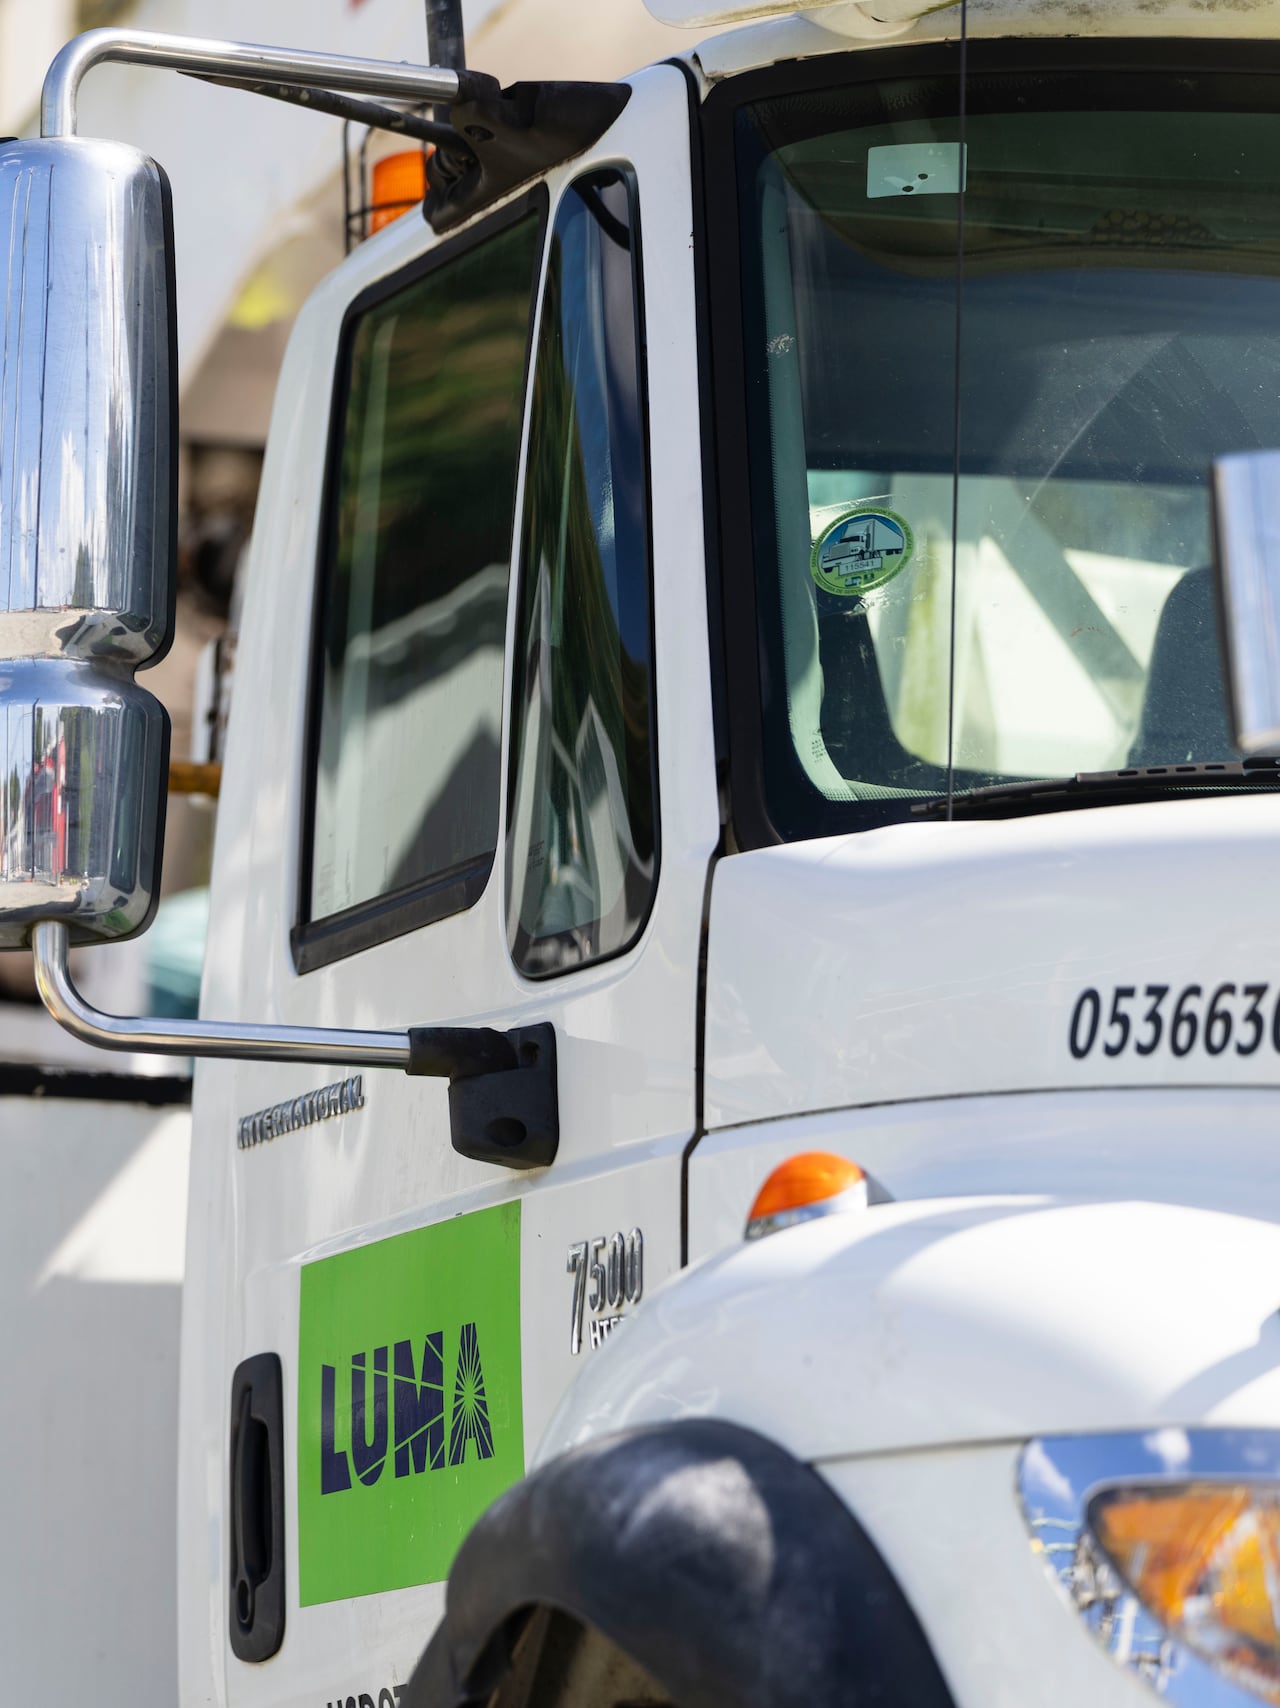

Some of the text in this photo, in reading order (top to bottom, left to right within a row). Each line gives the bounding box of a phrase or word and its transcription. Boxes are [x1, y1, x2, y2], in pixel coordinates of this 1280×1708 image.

[1068, 982, 1280, 1059] 053663
[237, 1074, 365, 1149] INTERNATIONAL
[567, 1227, 644, 1355] 7500
[321, 1321, 496, 1496] LUMA
